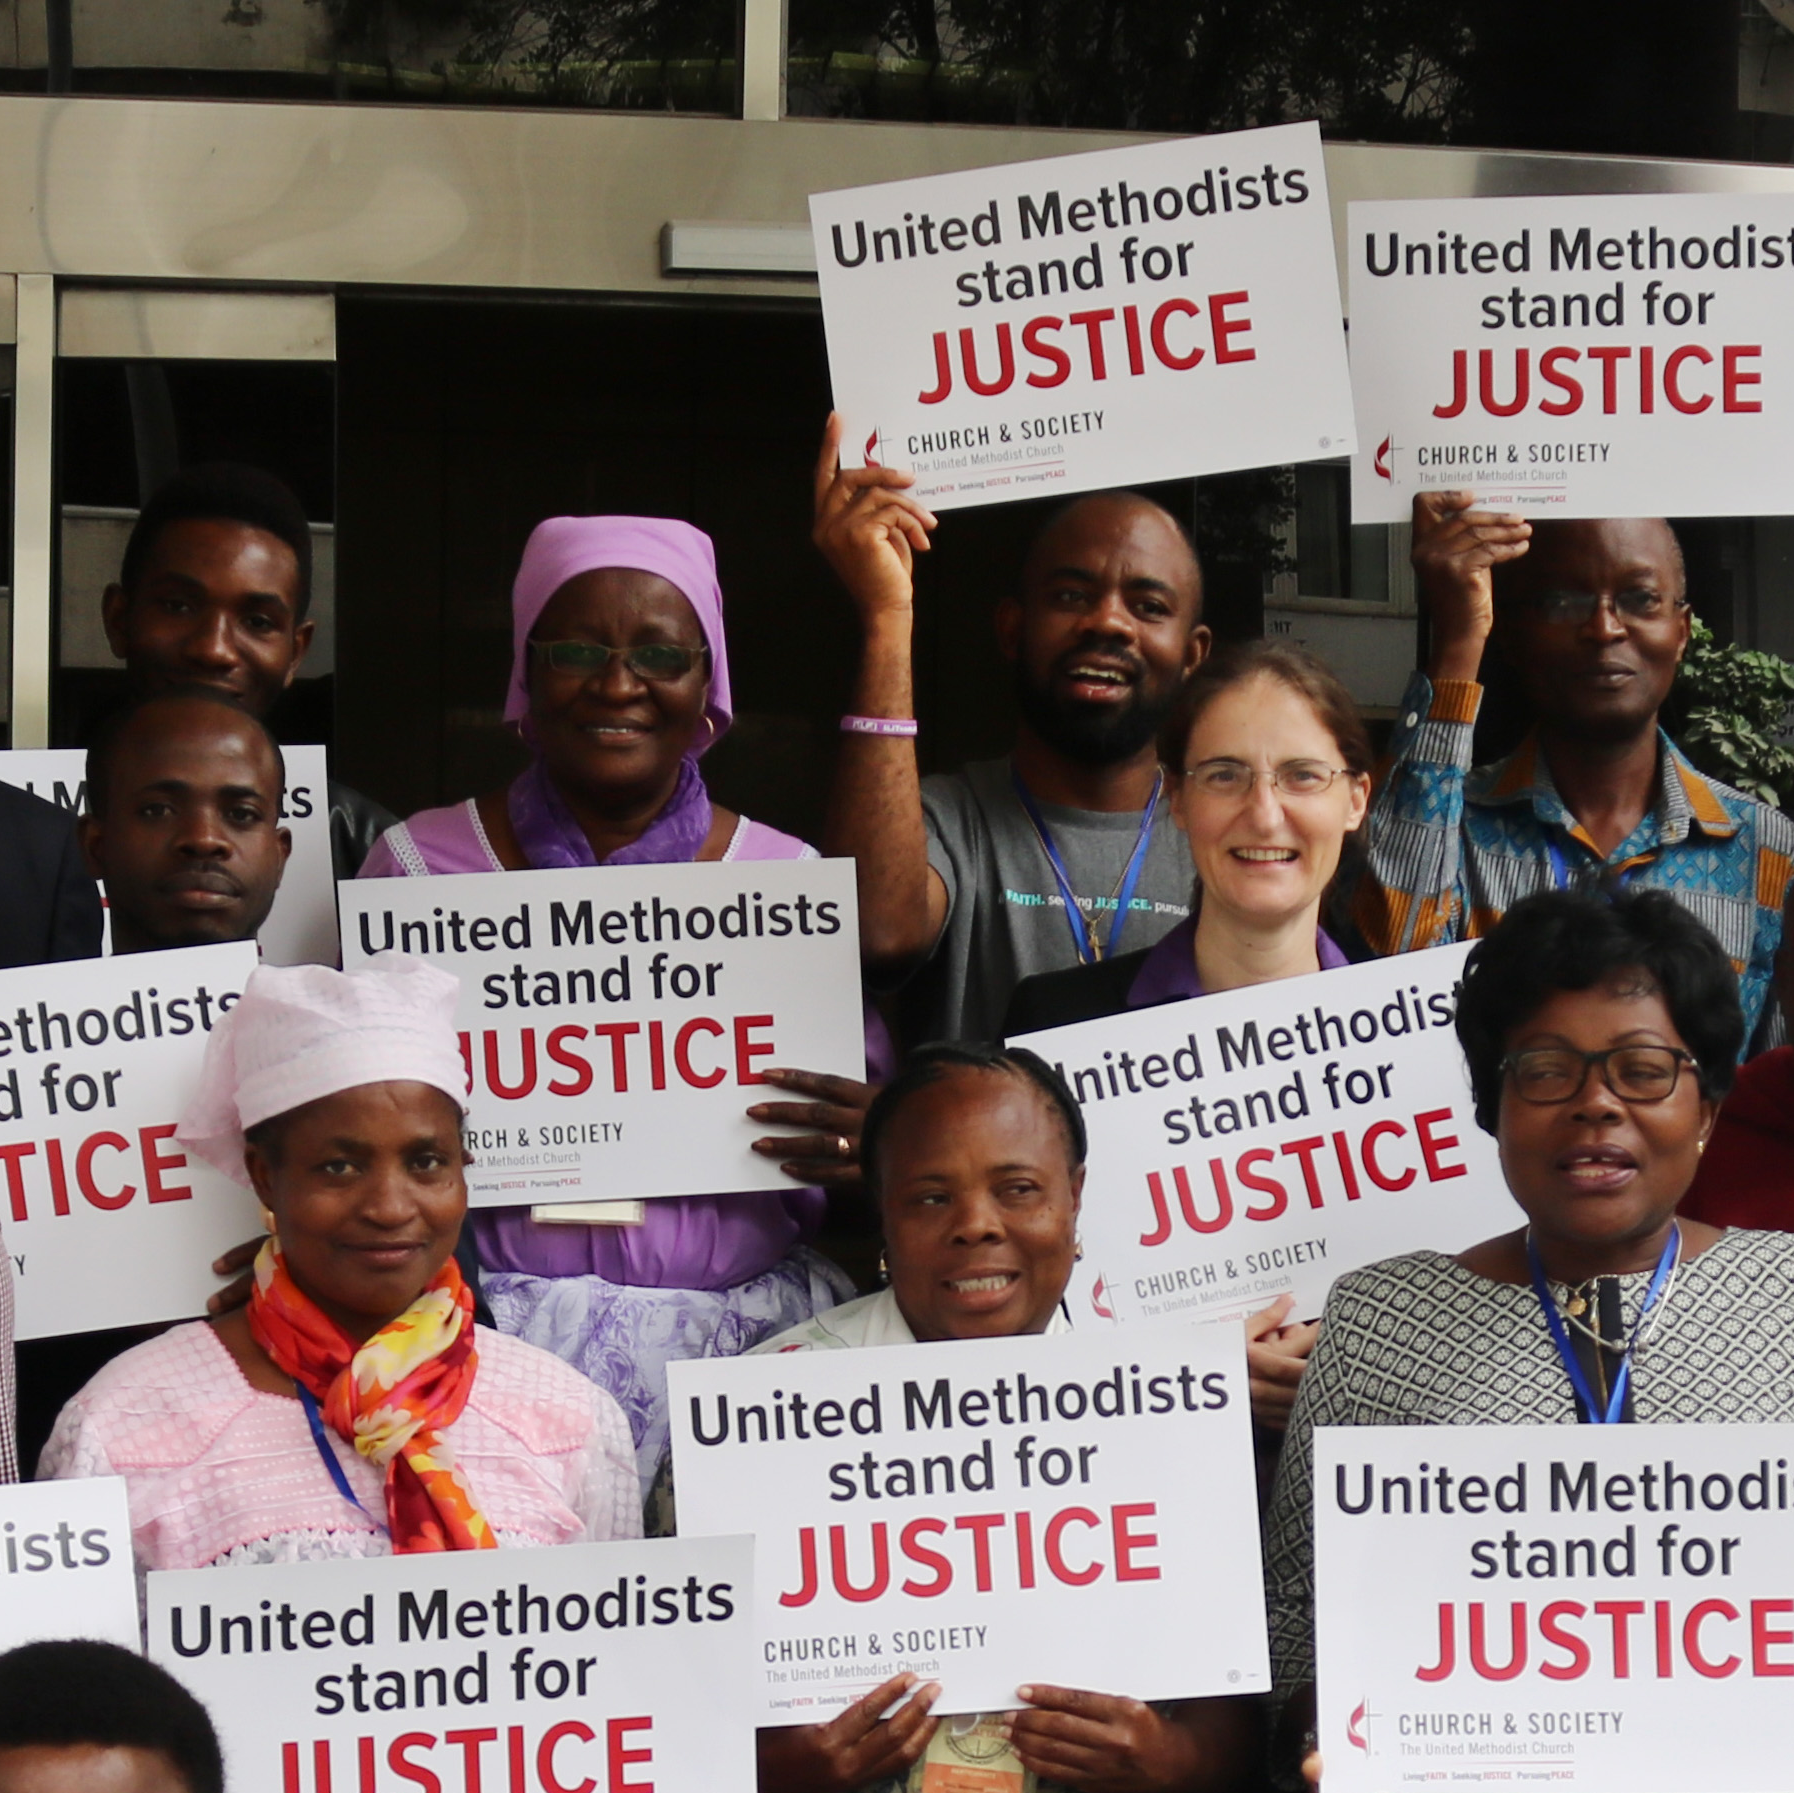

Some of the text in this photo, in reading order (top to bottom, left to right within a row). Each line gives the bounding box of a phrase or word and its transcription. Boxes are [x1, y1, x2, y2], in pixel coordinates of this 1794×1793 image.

[832, 165, 1309, 268] United Methodists
[957, 236, 1193, 307] stand for
[1366, 229, 1529, 277] United
[1482, 281, 1715, 329] stand for
[918, 291, 1255, 404] JUSTICE
[1433, 345, 1762, 418] JUSTICE
[908, 411, 1103, 454] CHURCH & SOCIETY
[1419, 444, 1609, 466] CHURCH & SOCIETY
[359, 892, 840, 956] United Methodists
[483, 952, 723, 1008] stand for
[40, 1063, 121, 1114] for
[1055, 1035, 1204, 1103] nited
[1164, 1062, 1393, 1144] stand for
[1140, 1108, 1467, 1246] JUSTICE
[691, 1364, 1228, 1446] United Methodists
[829, 1436, 1097, 1501] stand for
[1337, 1462, 1526, 1514] United
[779, 1502, 1161, 1608] JUSTICE
[1471, 1524, 1740, 1579] stand for
[171, 1575, 733, 1657] United Methodists
[316, 1647, 596, 1715] stand for
[1399, 1712, 1623, 1736] CHURCH & SOCIETY
